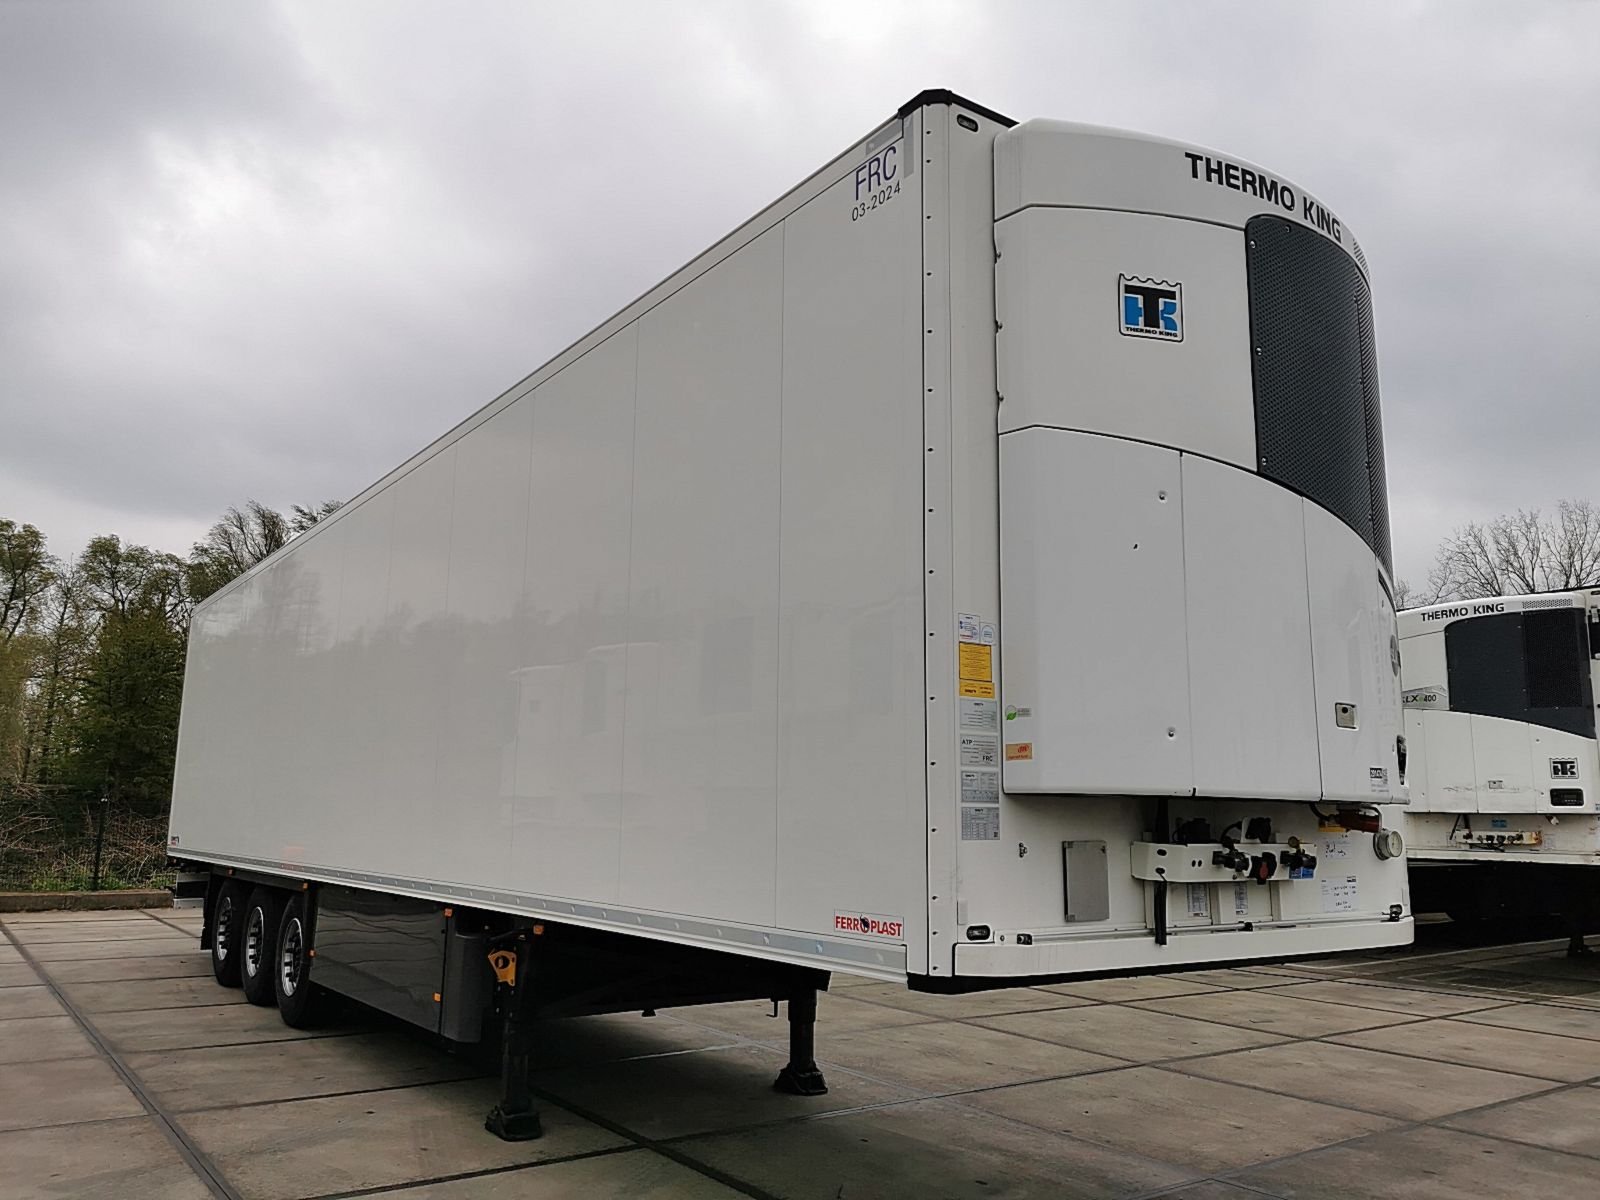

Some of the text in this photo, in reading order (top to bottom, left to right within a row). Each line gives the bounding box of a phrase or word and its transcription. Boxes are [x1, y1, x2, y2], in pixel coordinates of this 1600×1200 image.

[855, 146, 897, 201] FRC
[852, 180, 901, 221] 03-2024
[1184, 152, 1342, 244] THERMO KING
[1126, 327, 1178, 338] THERMO KING
[1421, 603, 1505, 621] THERMO KING
[835, 915, 902, 937] FERROPLAST
